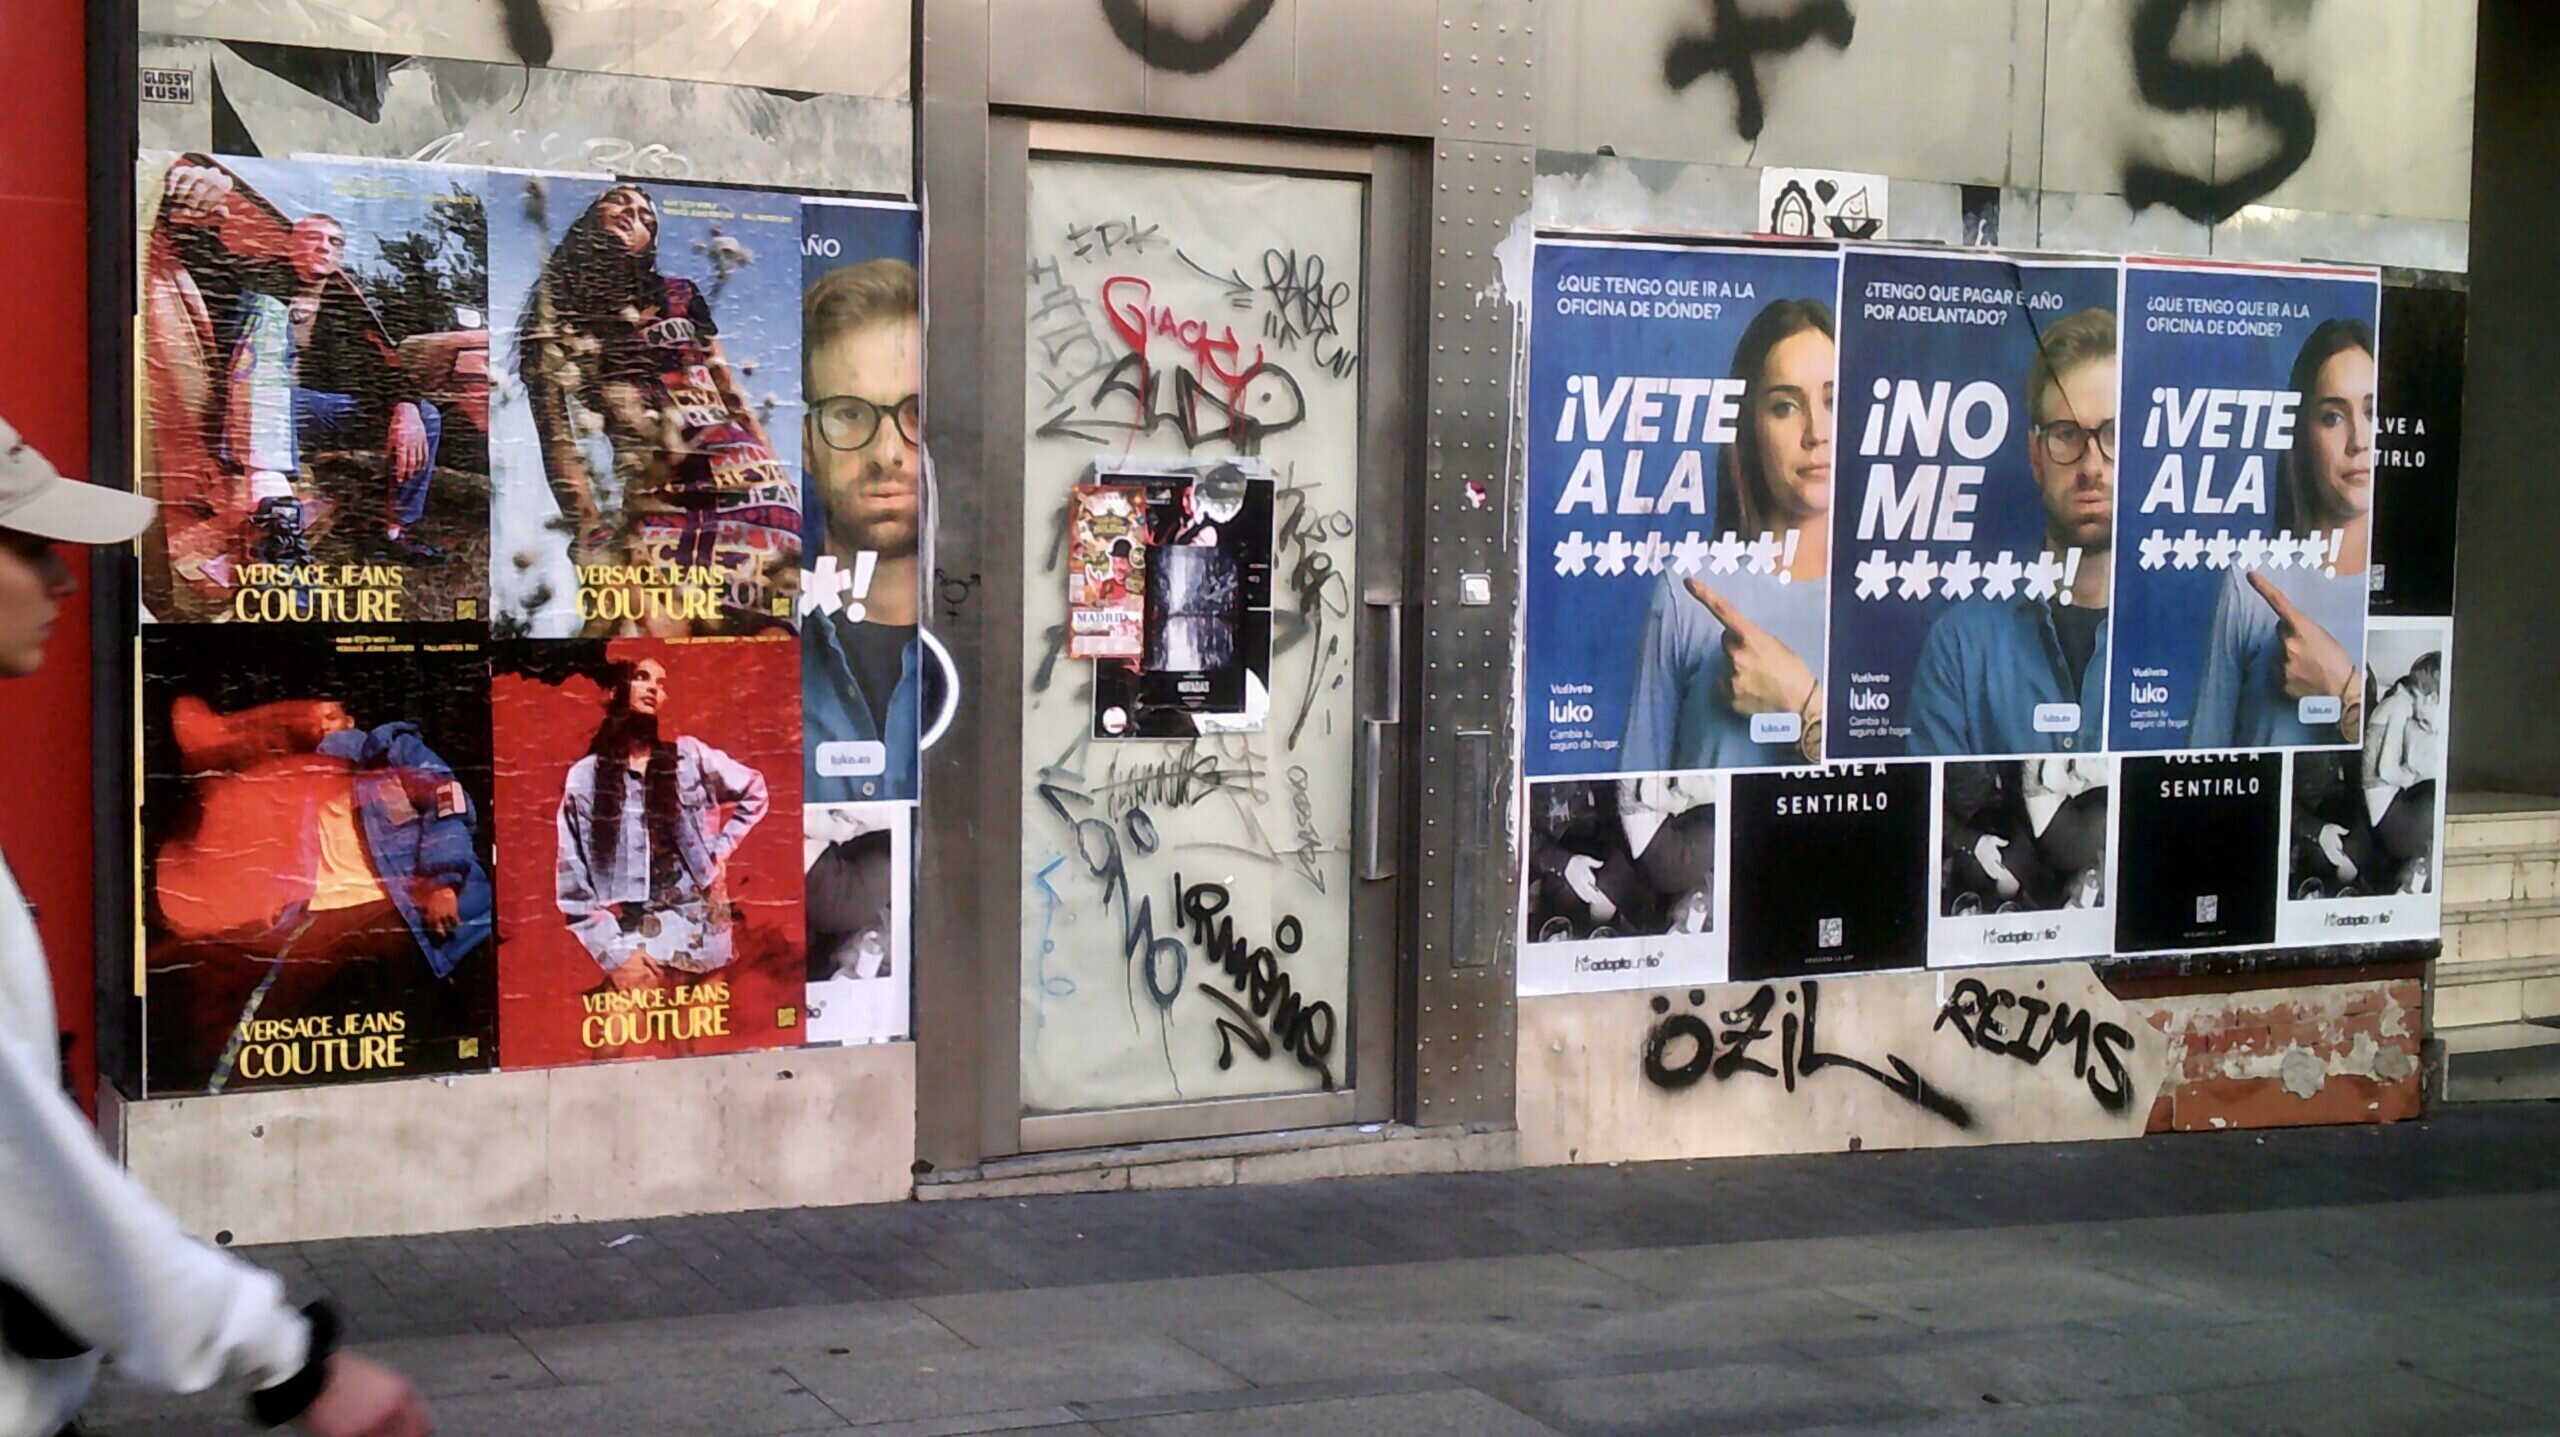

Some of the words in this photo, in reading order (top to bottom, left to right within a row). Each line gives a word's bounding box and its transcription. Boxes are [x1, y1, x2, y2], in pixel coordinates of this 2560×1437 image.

[144, 71, 190, 86] GLOSSY
[144, 85, 190, 100] KUSH
[1557, 274, 1601, 293] ¿QUE
[1603, 276, 1663, 296] TENGO
[1665, 279, 1699, 297] QUE
[1702, 280, 1718, 298] IR
[1719, 281, 1731, 299] A
[1734, 282, 1755, 300] LA
[1865, 282, 1927, 300] ¿TENGO
[1929, 285, 1960, 303] QUE
[1963, 287, 2013, 305] PAGAR
[2029, 290, 2064, 310] AÑO
[1556, 297, 1628, 317] OFICINA
[1630, 300, 1651, 318] DE
[1654, 299, 1722, 320] DÓNDE?
[1864, 303, 1895, 321] POR
[1897, 304, 2008, 326] ADELANTADO?
[2146, 296, 2184, 314] ¿QUE
[2186, 298, 2234, 316] TENGO
[2236, 300, 2265, 317] QUE
[2267, 301, 2280, 318] IR
[2281, 302, 2292, 318] A
[2293, 302, 2311, 319] LA
[2146, 316, 2205, 334] OFICINA
[2207, 318, 2226, 336] DE
[2227, 318, 2283, 338] DÓNDE?
[1555, 375, 1747, 443] ¡VETE
[1859, 377, 2010, 460] ¡NO
[2142, 386, 2303, 450] ¡VETE
[2414, 418, 2426, 435] A
[2374, 449, 2426, 467] TIRLO
[1856, 463, 1987, 541] ME
[235, 564, 330, 587] VERSACE
[333, 564, 404, 587] JEANS
[576, 564, 661, 587] VERSACE
[662, 564, 725, 587] JEANS
[235, 587, 403, 622] COUTURE
[576, 587, 725, 620] COUTURE
[1076, 612, 1129, 623] MADRID
[1849, 687, 1890, 711] luko
[2131, 681, 2169, 703] luko
[1549, 699, 1593, 723] luko
[2160, 777, 2260, 798] SENTIRLO
[1776, 792, 1888, 815] SENTIRLO
[582, 987, 665, 1014] VERSACE
[668, 982, 730, 1007] JEANS
[239, 1015, 333, 1042] VERSACE
[336, 1010, 405, 1037] JEANS
[582, 1004, 730, 1049] COUTURE
[239, 1034, 405, 1079] COUTURE
